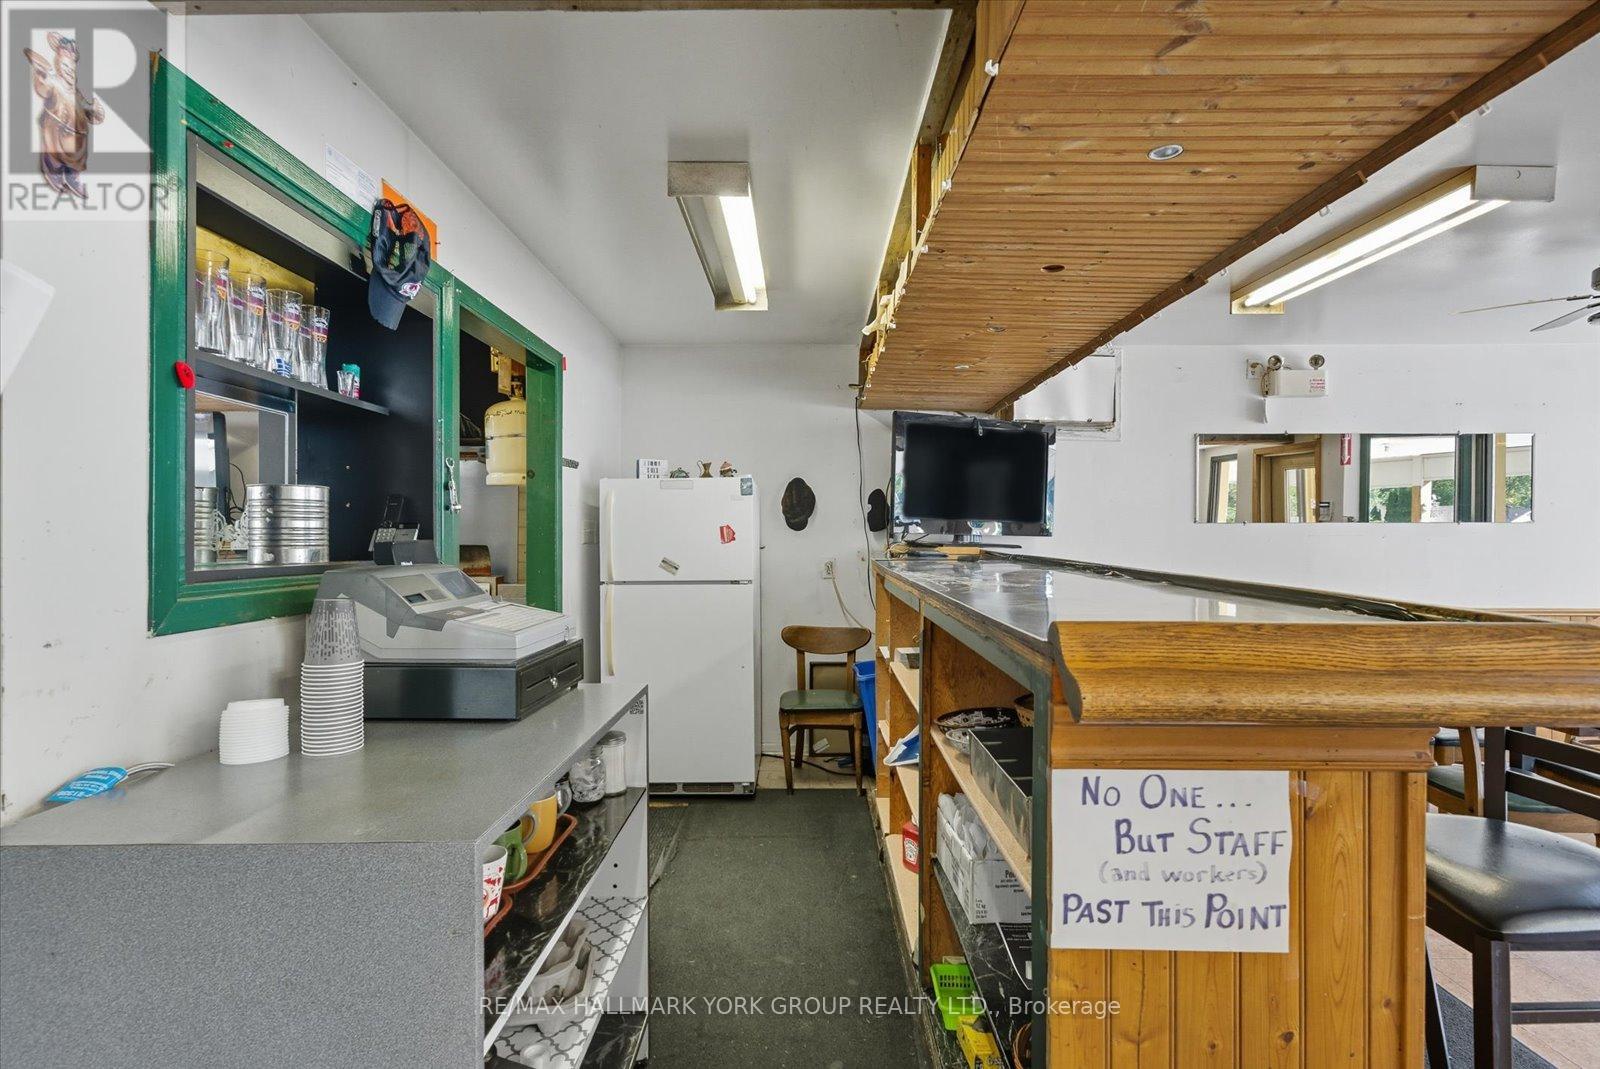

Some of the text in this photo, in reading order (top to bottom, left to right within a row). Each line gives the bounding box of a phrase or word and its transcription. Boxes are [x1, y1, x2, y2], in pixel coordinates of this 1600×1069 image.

[1187, 817, 1288, 858] STAFF
[1099, 861, 1268, 885] (and workers)
[1062, 893, 1130, 925] PAST
[1204, 893, 1287, 931] POINT
